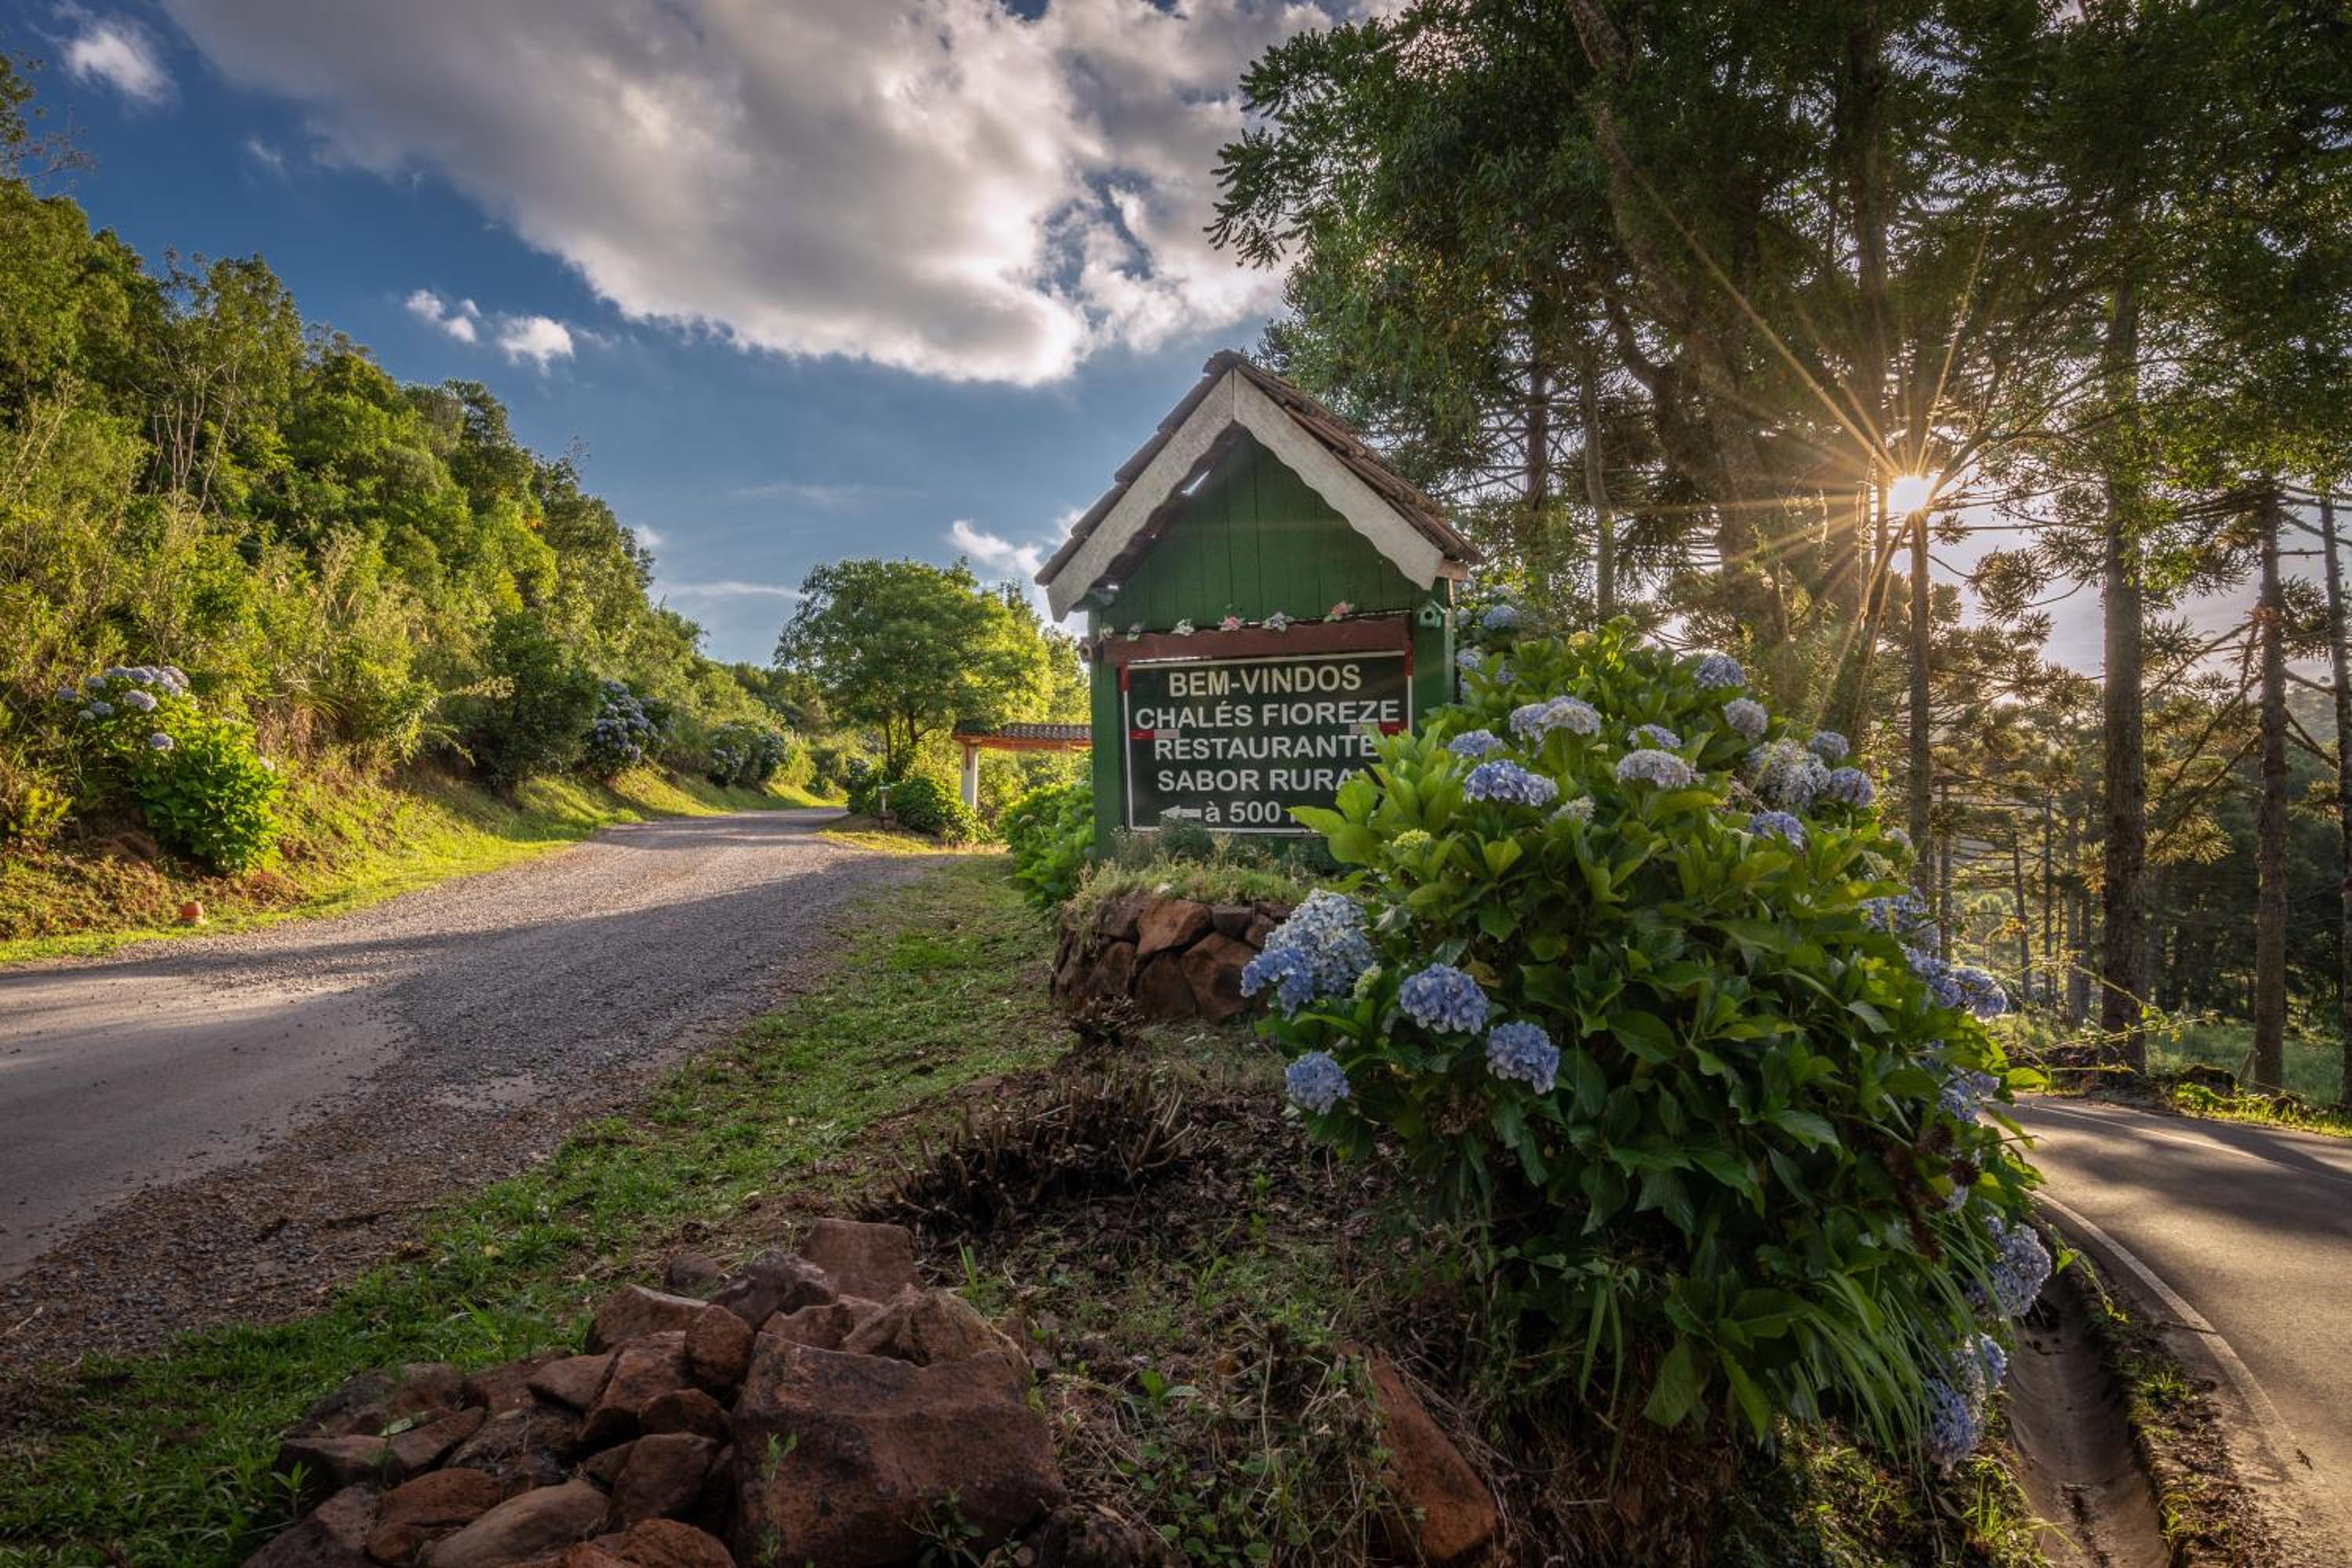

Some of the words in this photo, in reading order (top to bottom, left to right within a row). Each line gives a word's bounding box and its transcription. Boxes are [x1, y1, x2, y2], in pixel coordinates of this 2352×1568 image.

[1169, 664, 1361, 697] BEM-VINDOS
[1135, 700, 1254, 730] CHALÉS
[1262, 699, 1399, 727] FIOREZE
[1155, 735, 1379, 760] RESTAURANTE
[1157, 768, 1260, 792] SABOR
[1269, 768, 1366, 791] RURA
[1205, 800, 1221, 822] à
[1229, 800, 1281, 822] 500
